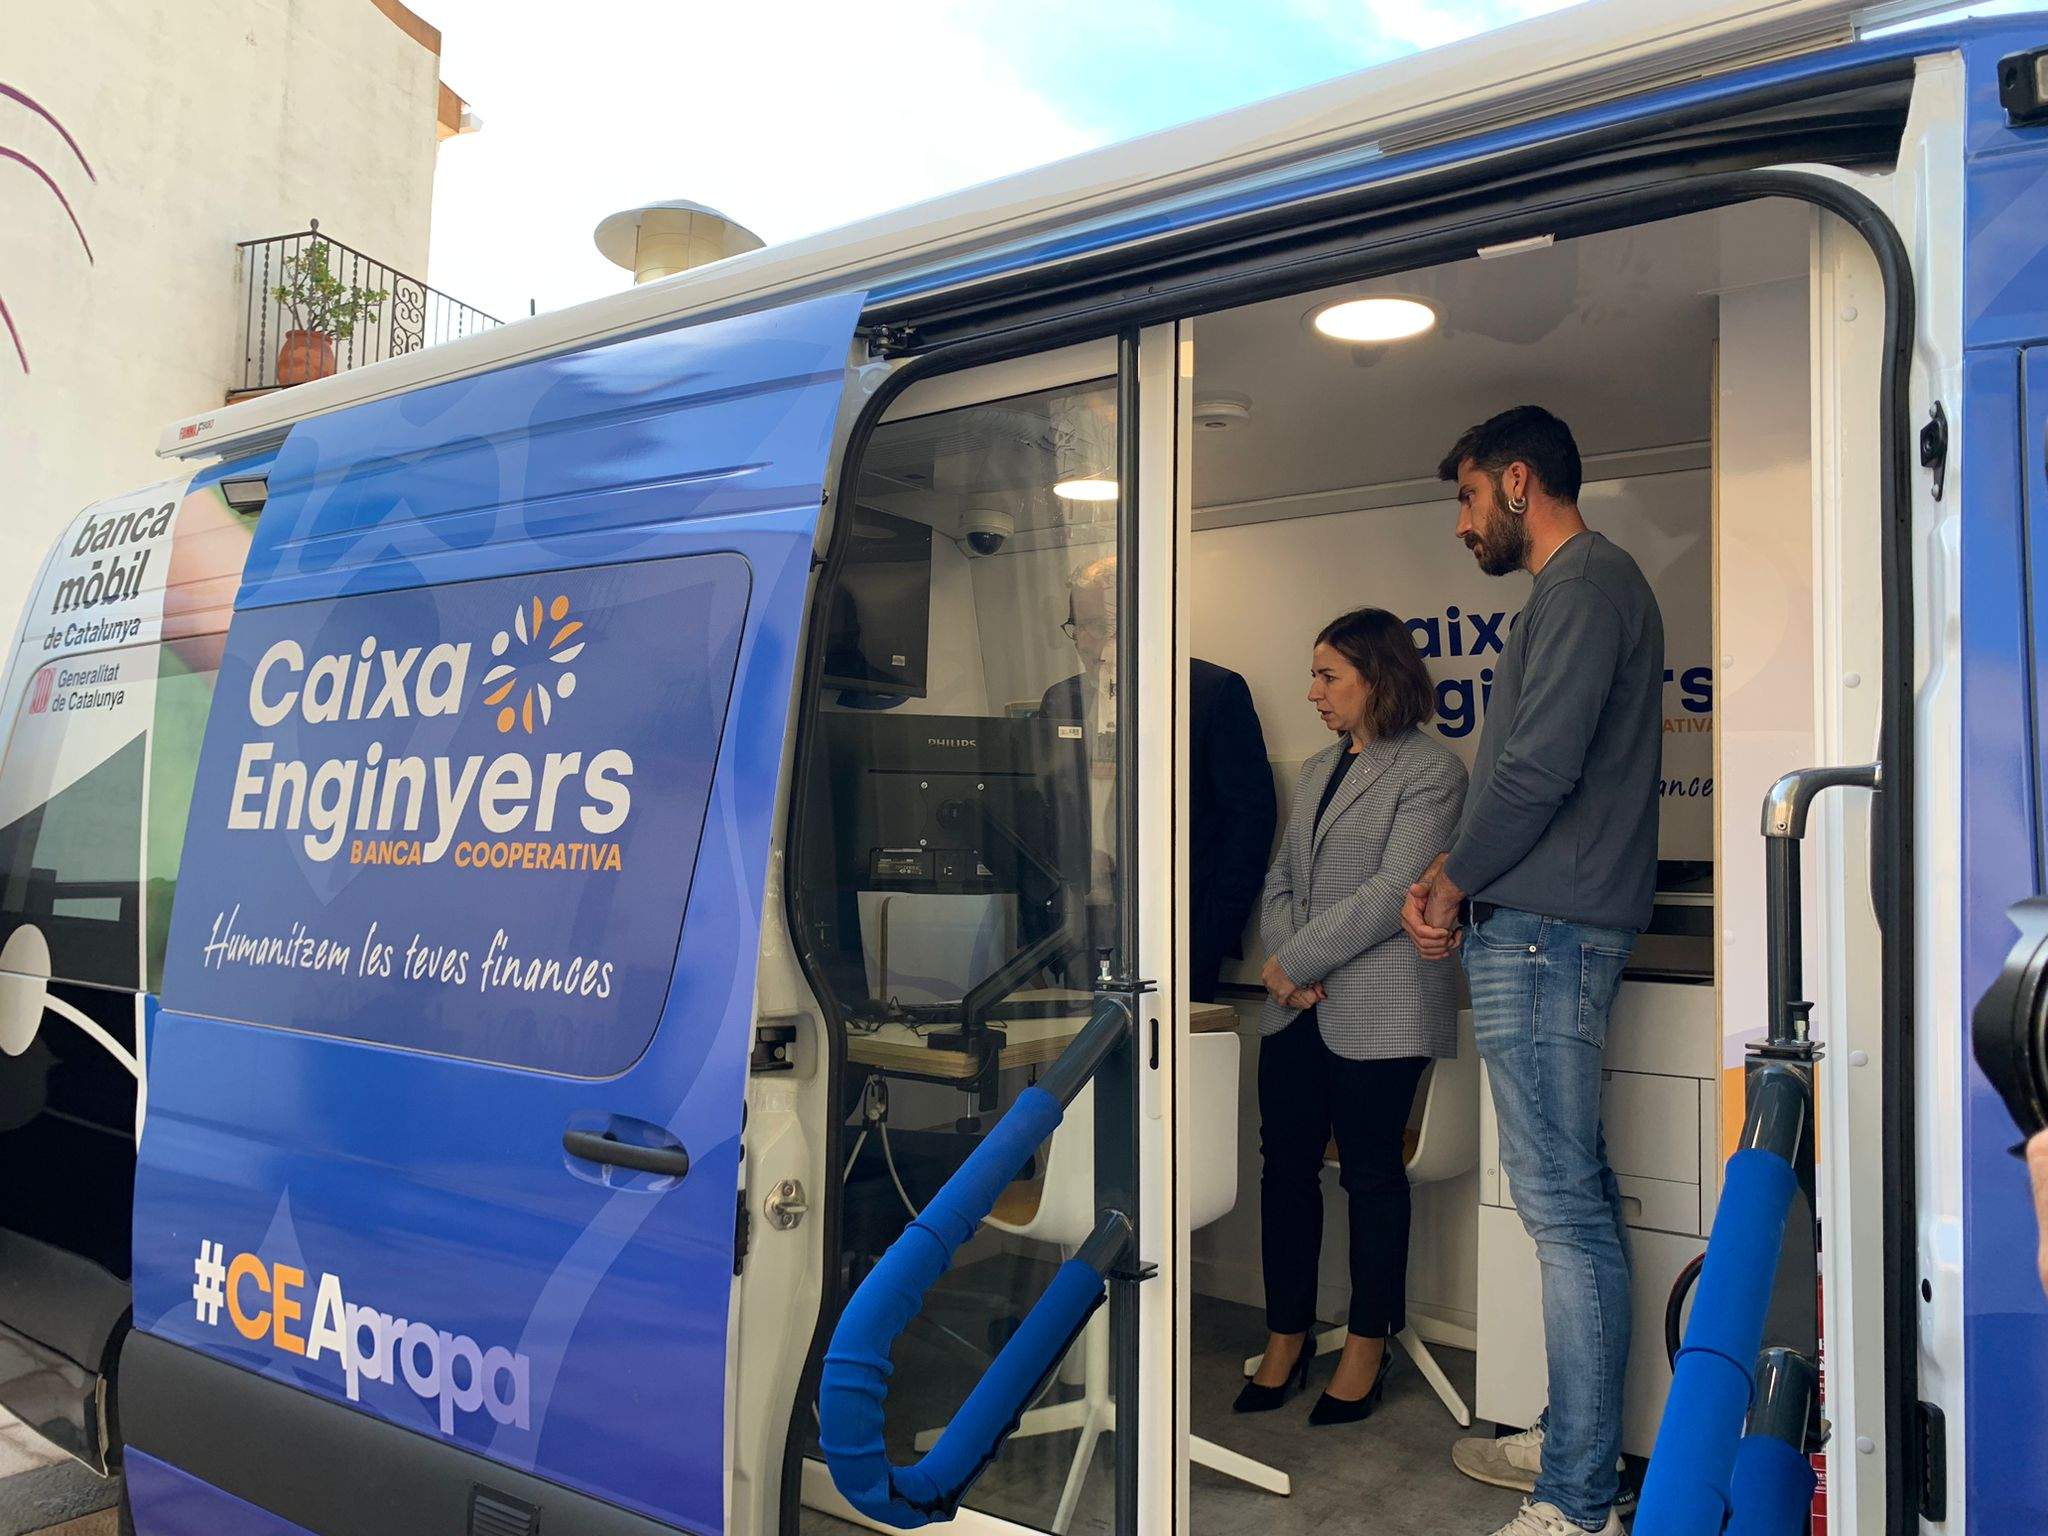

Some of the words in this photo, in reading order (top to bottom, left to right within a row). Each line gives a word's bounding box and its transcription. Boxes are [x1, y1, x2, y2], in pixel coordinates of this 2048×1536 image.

[70, 501, 176, 558] banca
[43, 627, 63, 650] de
[64, 617, 141, 647] Catalunya
[1403, 605, 1521, 660] aix
[52, 694, 66, 712] de
[68, 689, 125, 711] Catalunya
[58, 663, 120, 688] Generalitat
[248, 635, 472, 727] Caixa
[928, 738, 976, 748] PHILIPS
[227, 742, 634, 863] Enginyers
[349, 840, 422, 866] BANCA
[455, 842, 622, 871] COOPERATIVA
[203, 903, 350, 977] Humanitzem
[359, 921, 394, 978] les
[403, 935, 469, 986] teves
[480, 928, 615, 999] finances
[193, 1239, 531, 1436] #CEApropa
